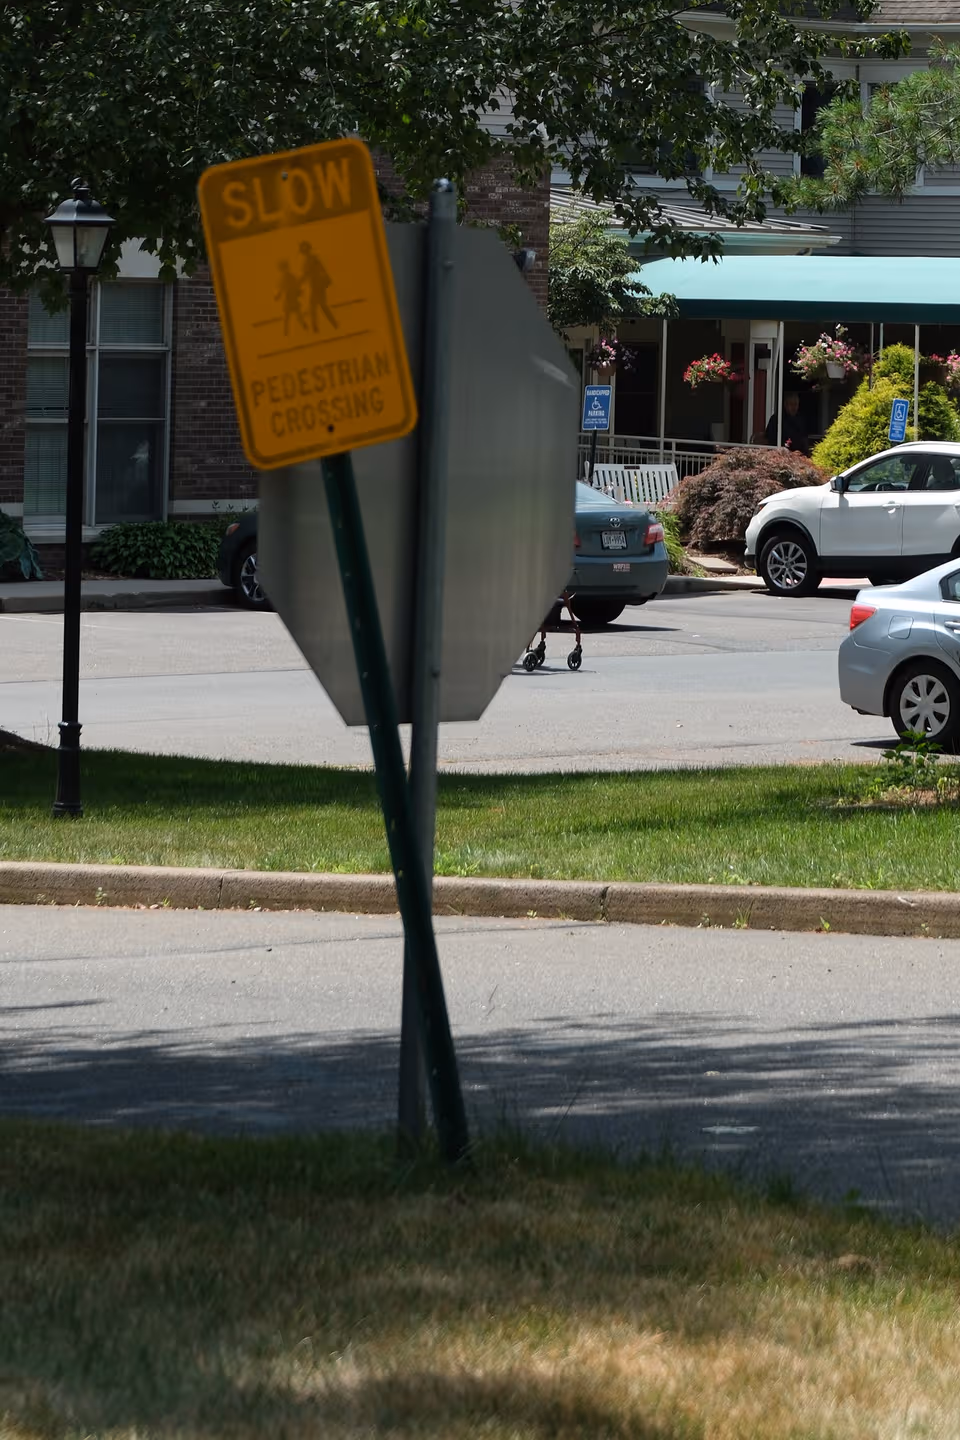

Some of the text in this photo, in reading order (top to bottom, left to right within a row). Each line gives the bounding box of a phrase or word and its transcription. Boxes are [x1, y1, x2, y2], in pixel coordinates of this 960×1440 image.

[223, 159, 350, 228] SLOW
[251, 351, 391, 407] PEDESTRIAN
[270, 386, 385, 438] CROSSING
